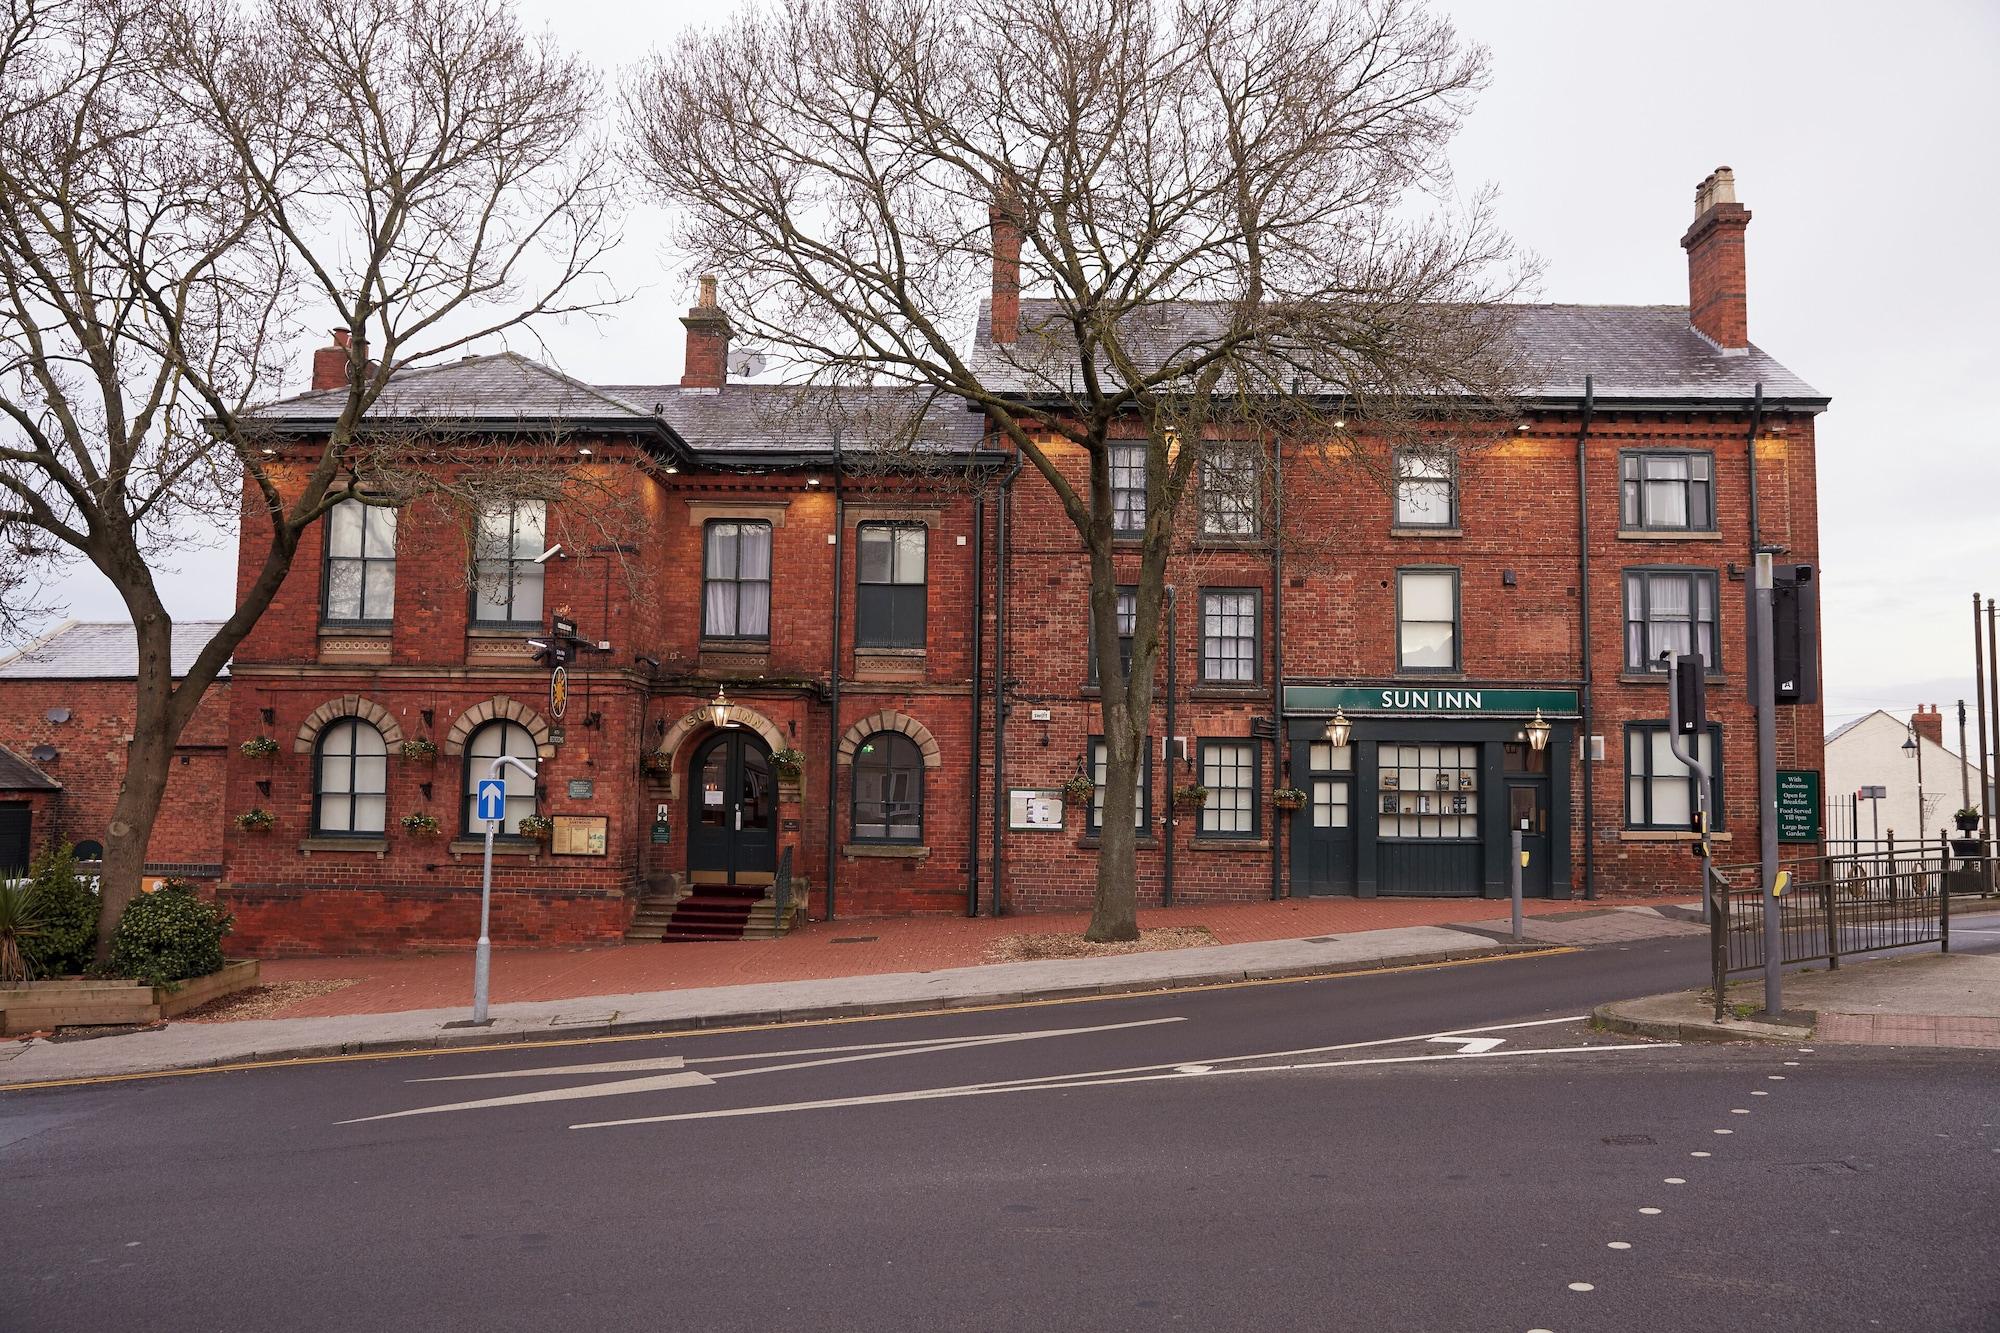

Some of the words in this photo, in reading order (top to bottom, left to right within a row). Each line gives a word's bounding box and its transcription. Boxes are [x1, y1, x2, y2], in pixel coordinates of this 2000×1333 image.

[1381, 690, 1429, 708] SUN
[1437, 691, 1482, 709] INN
[686, 710, 709, 727] SU
[735, 709, 764, 728] INN
